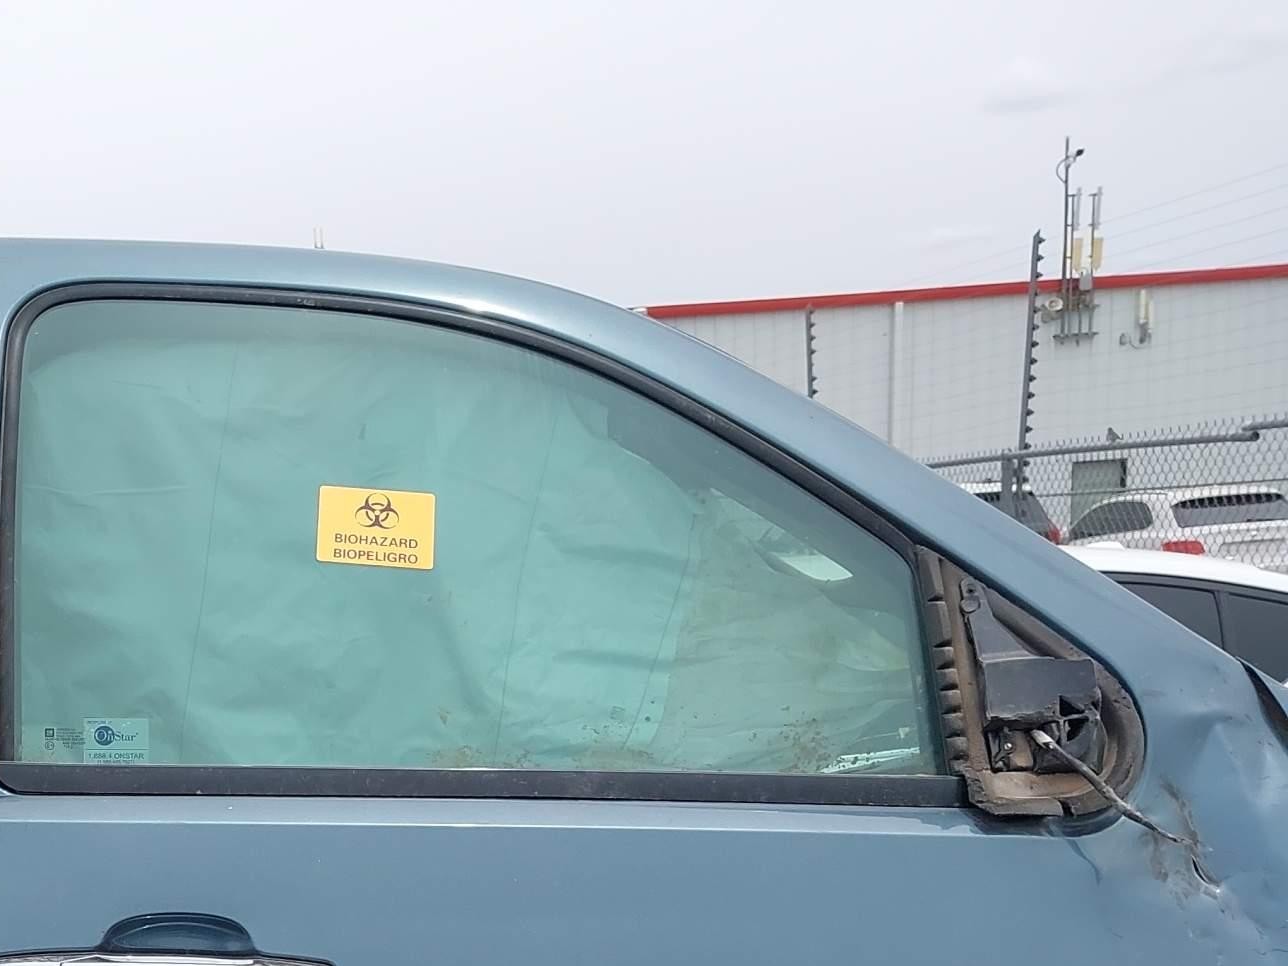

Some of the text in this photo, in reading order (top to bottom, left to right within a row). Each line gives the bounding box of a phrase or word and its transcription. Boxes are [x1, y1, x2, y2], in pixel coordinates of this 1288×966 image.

[334, 532, 419, 549] BIOHAZARD
[333, 548, 419, 565] BIOPELIGRO
[94, 728, 137, 743] OnStar
